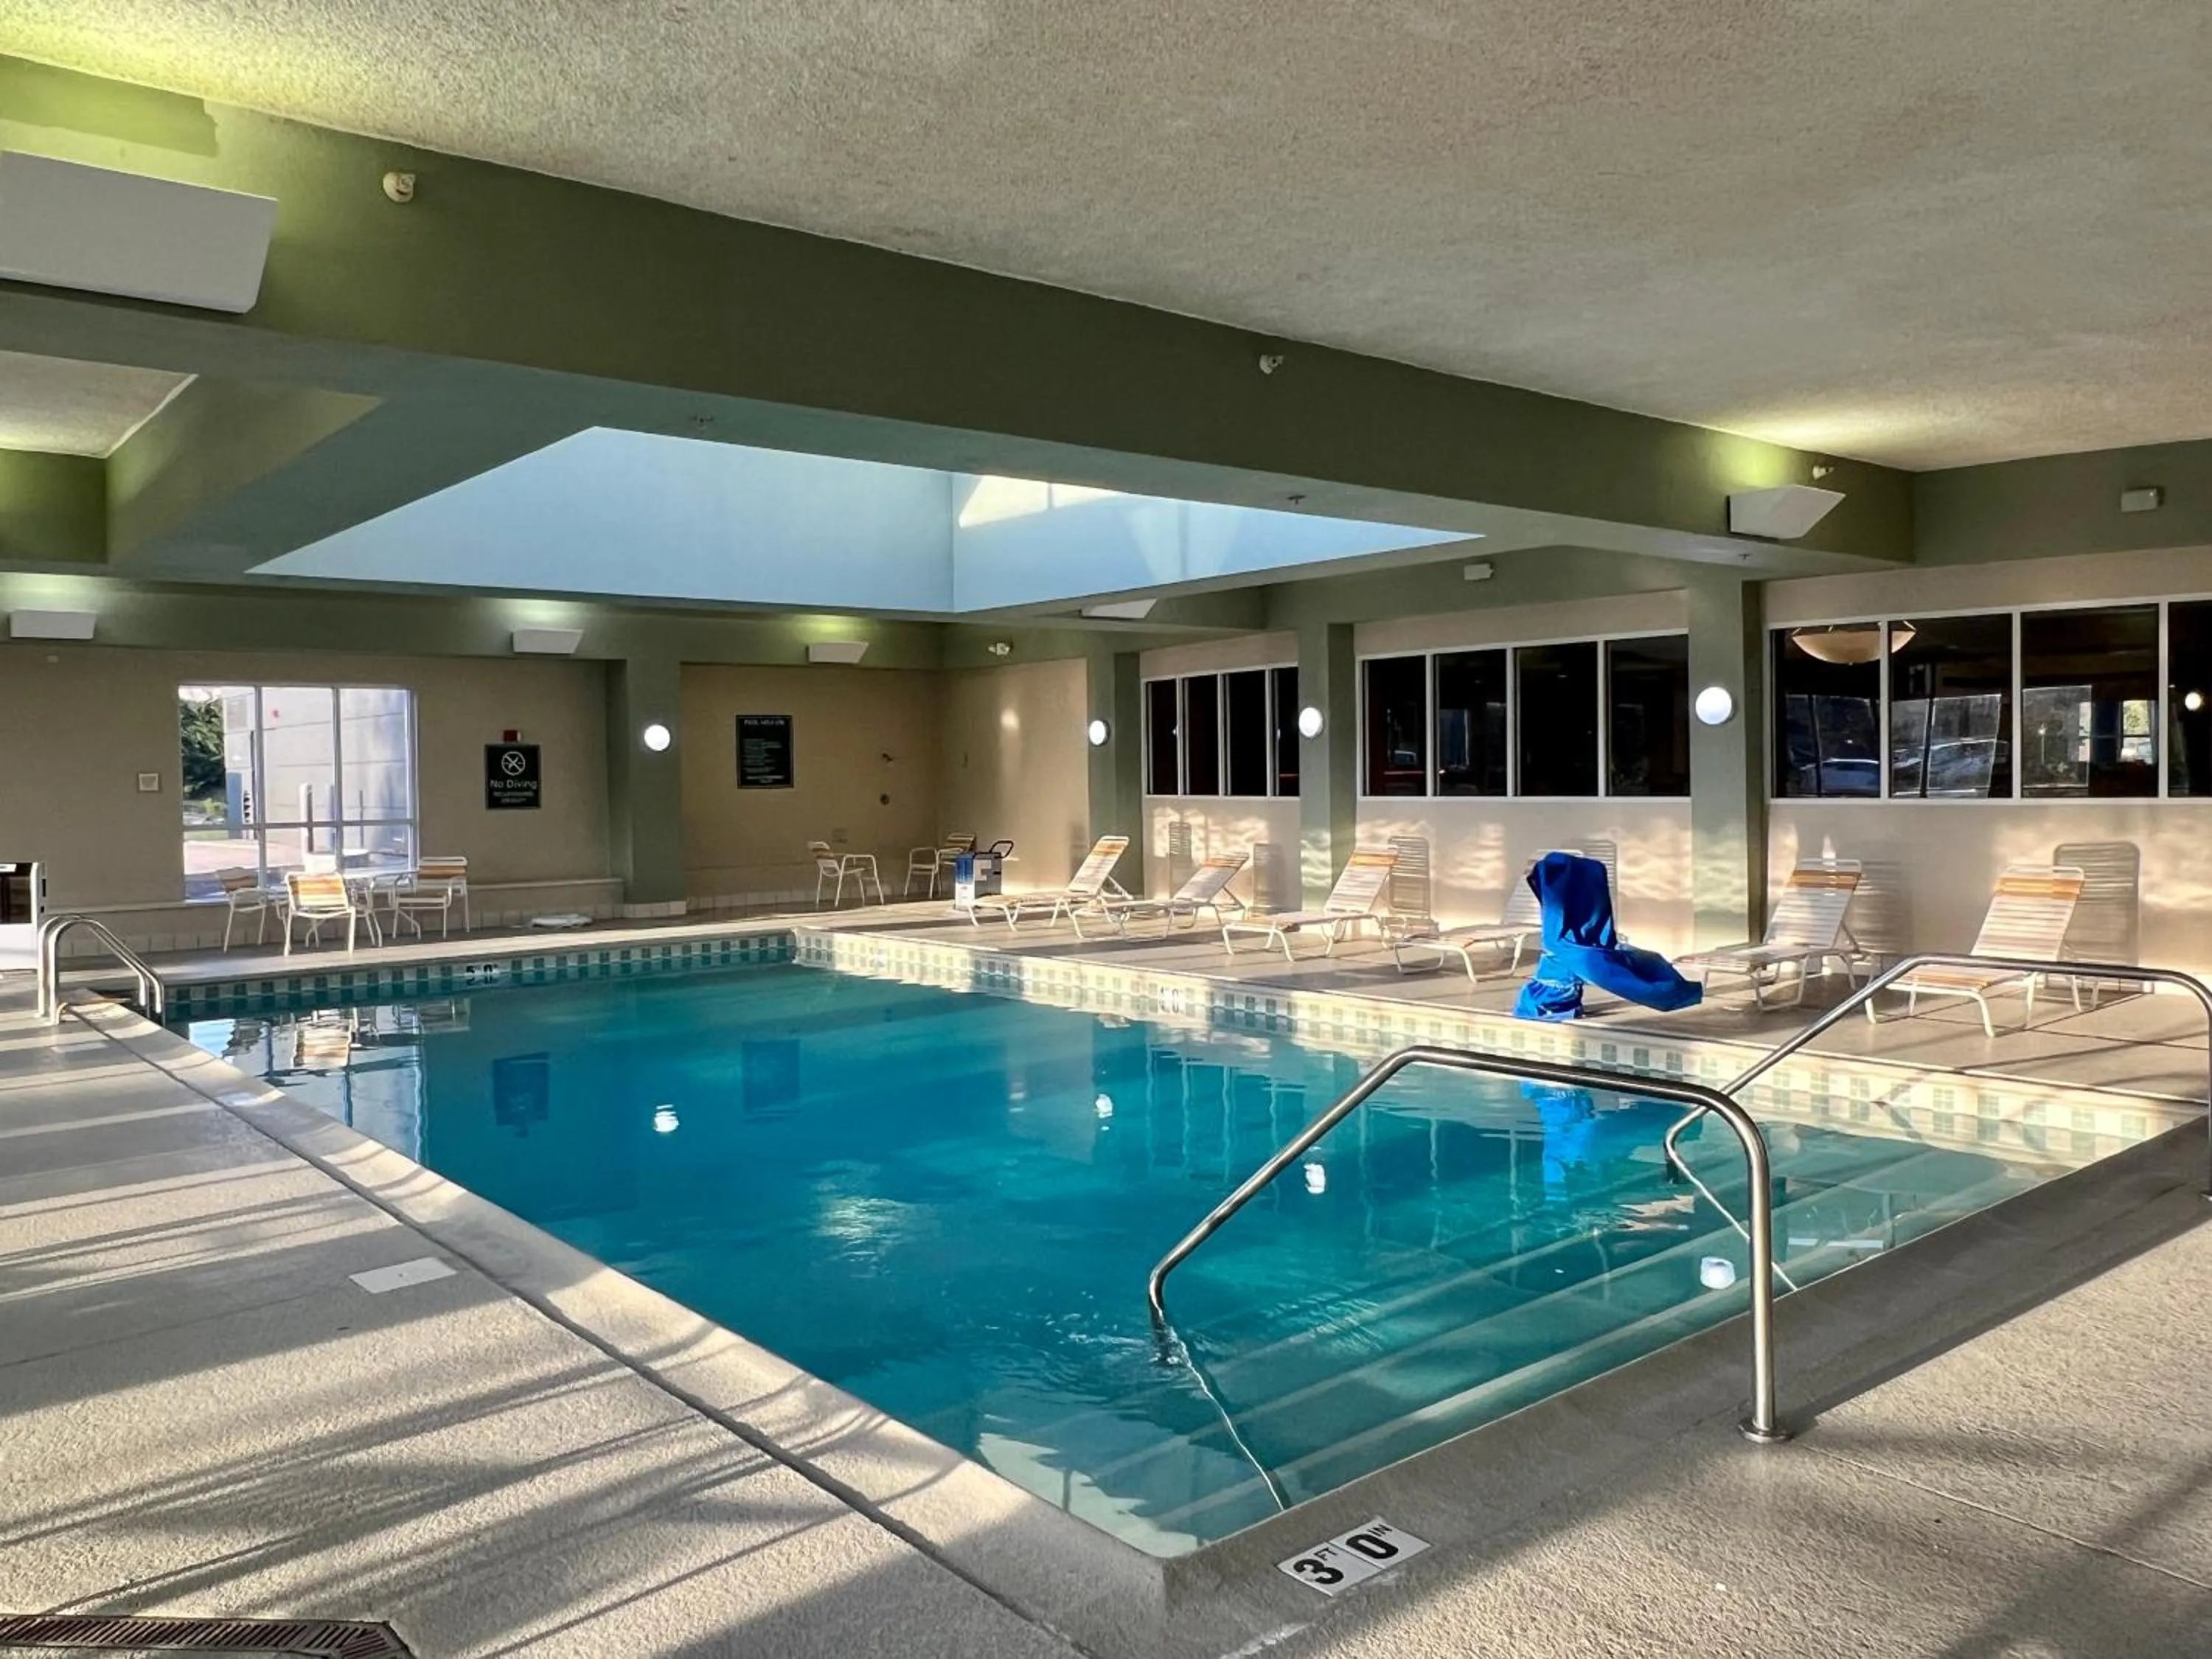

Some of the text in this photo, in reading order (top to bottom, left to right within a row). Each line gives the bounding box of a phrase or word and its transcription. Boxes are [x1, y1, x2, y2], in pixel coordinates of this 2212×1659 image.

[490, 779, 537, 789] No Diving
[1293, 1523, 1399, 1584] 3 FT 0 IN
